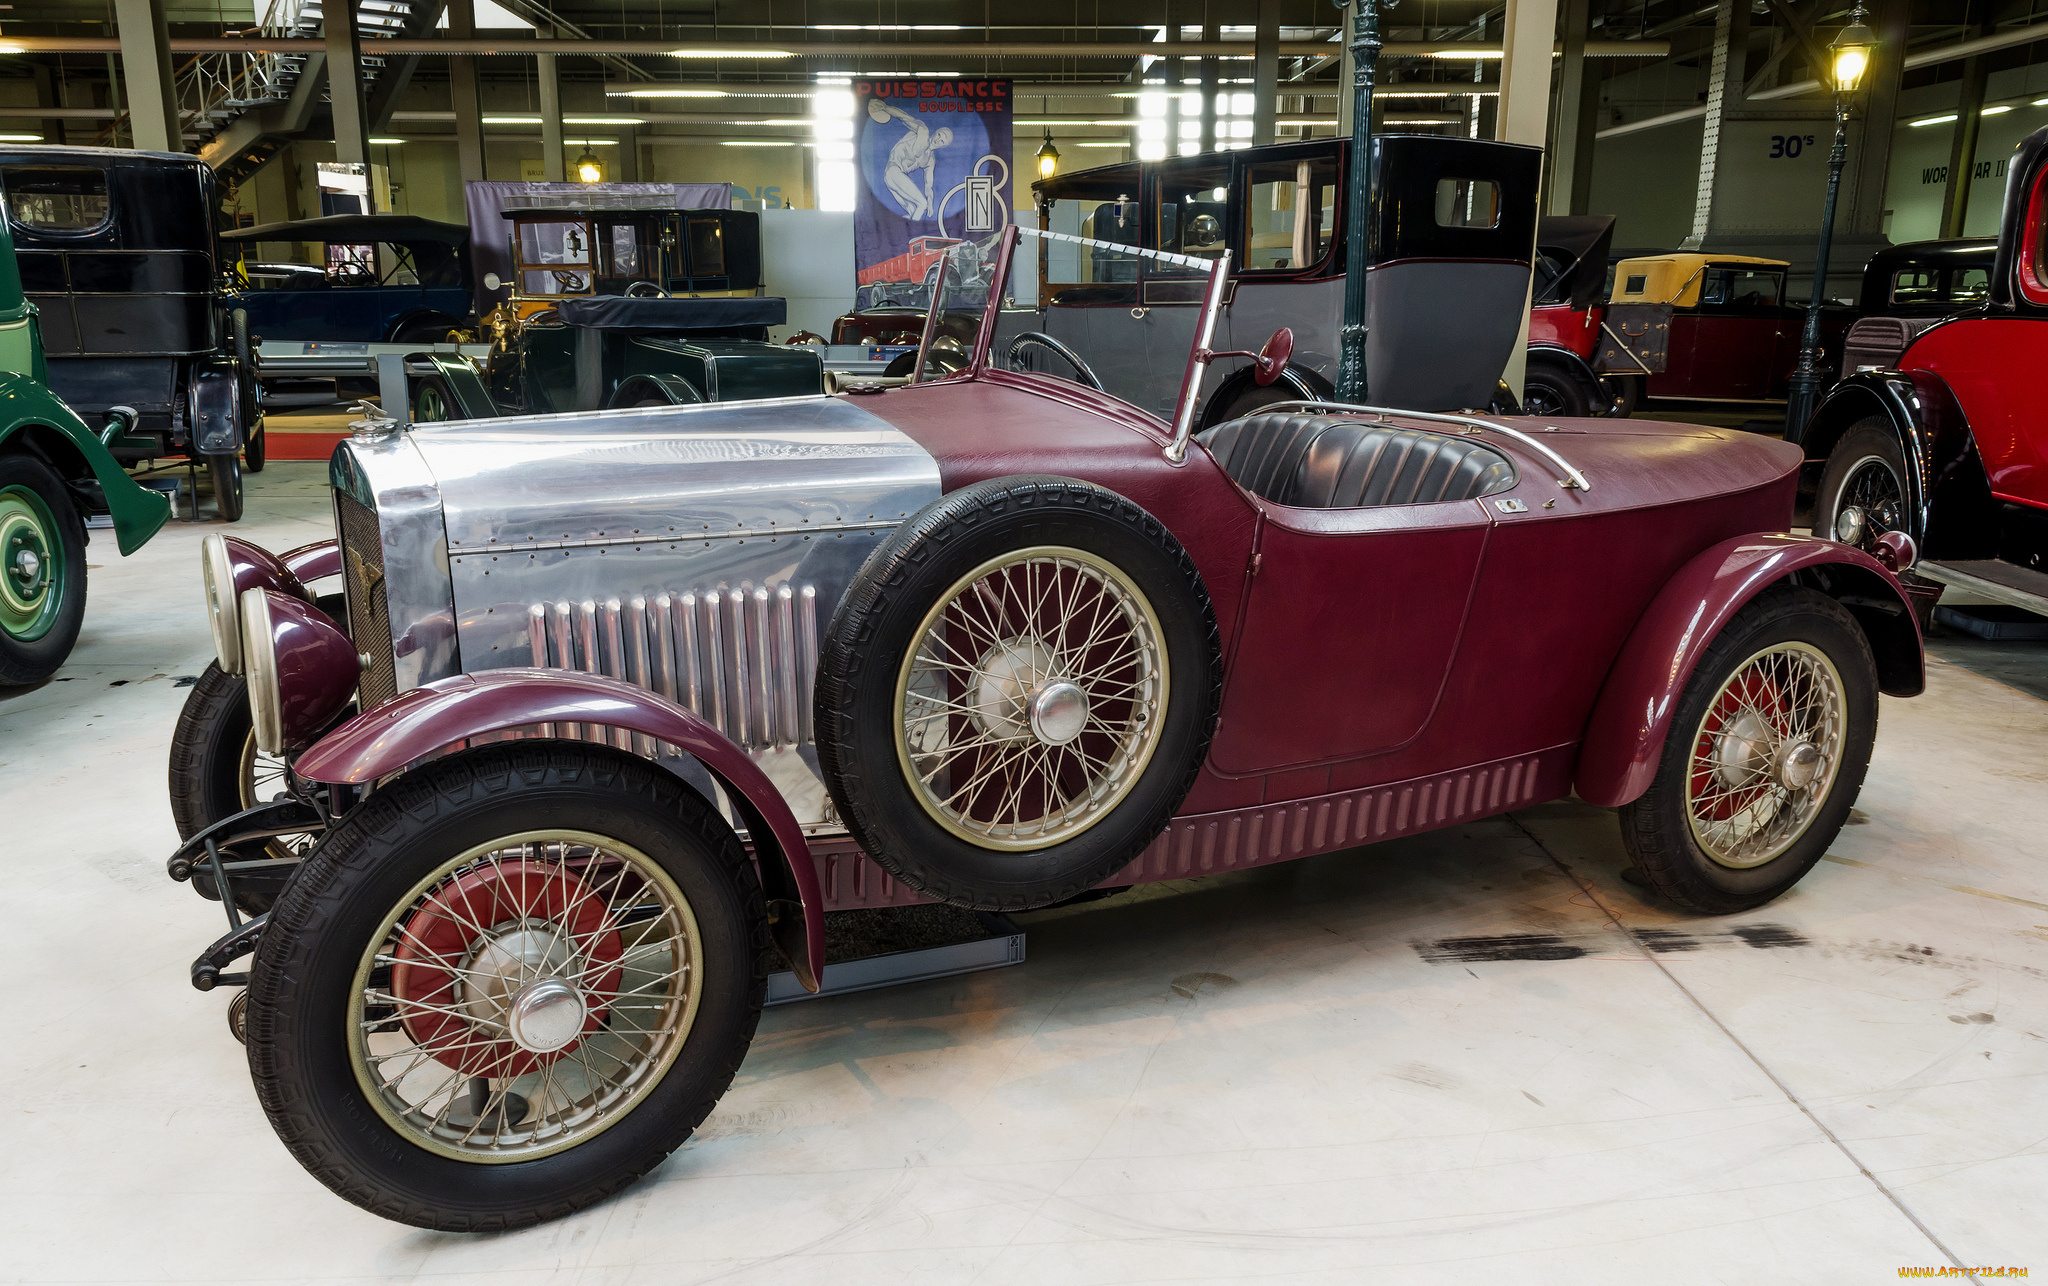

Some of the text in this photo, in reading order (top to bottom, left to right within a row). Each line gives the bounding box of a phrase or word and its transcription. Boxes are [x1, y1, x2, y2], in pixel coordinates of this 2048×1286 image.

[856, 82, 1006, 98] PUISSANCE
[919, 101, 1004, 112] SOUPLESSE
[1922, 160, 2006, 184] WOR AR II
[970, 181, 989, 227] FN
